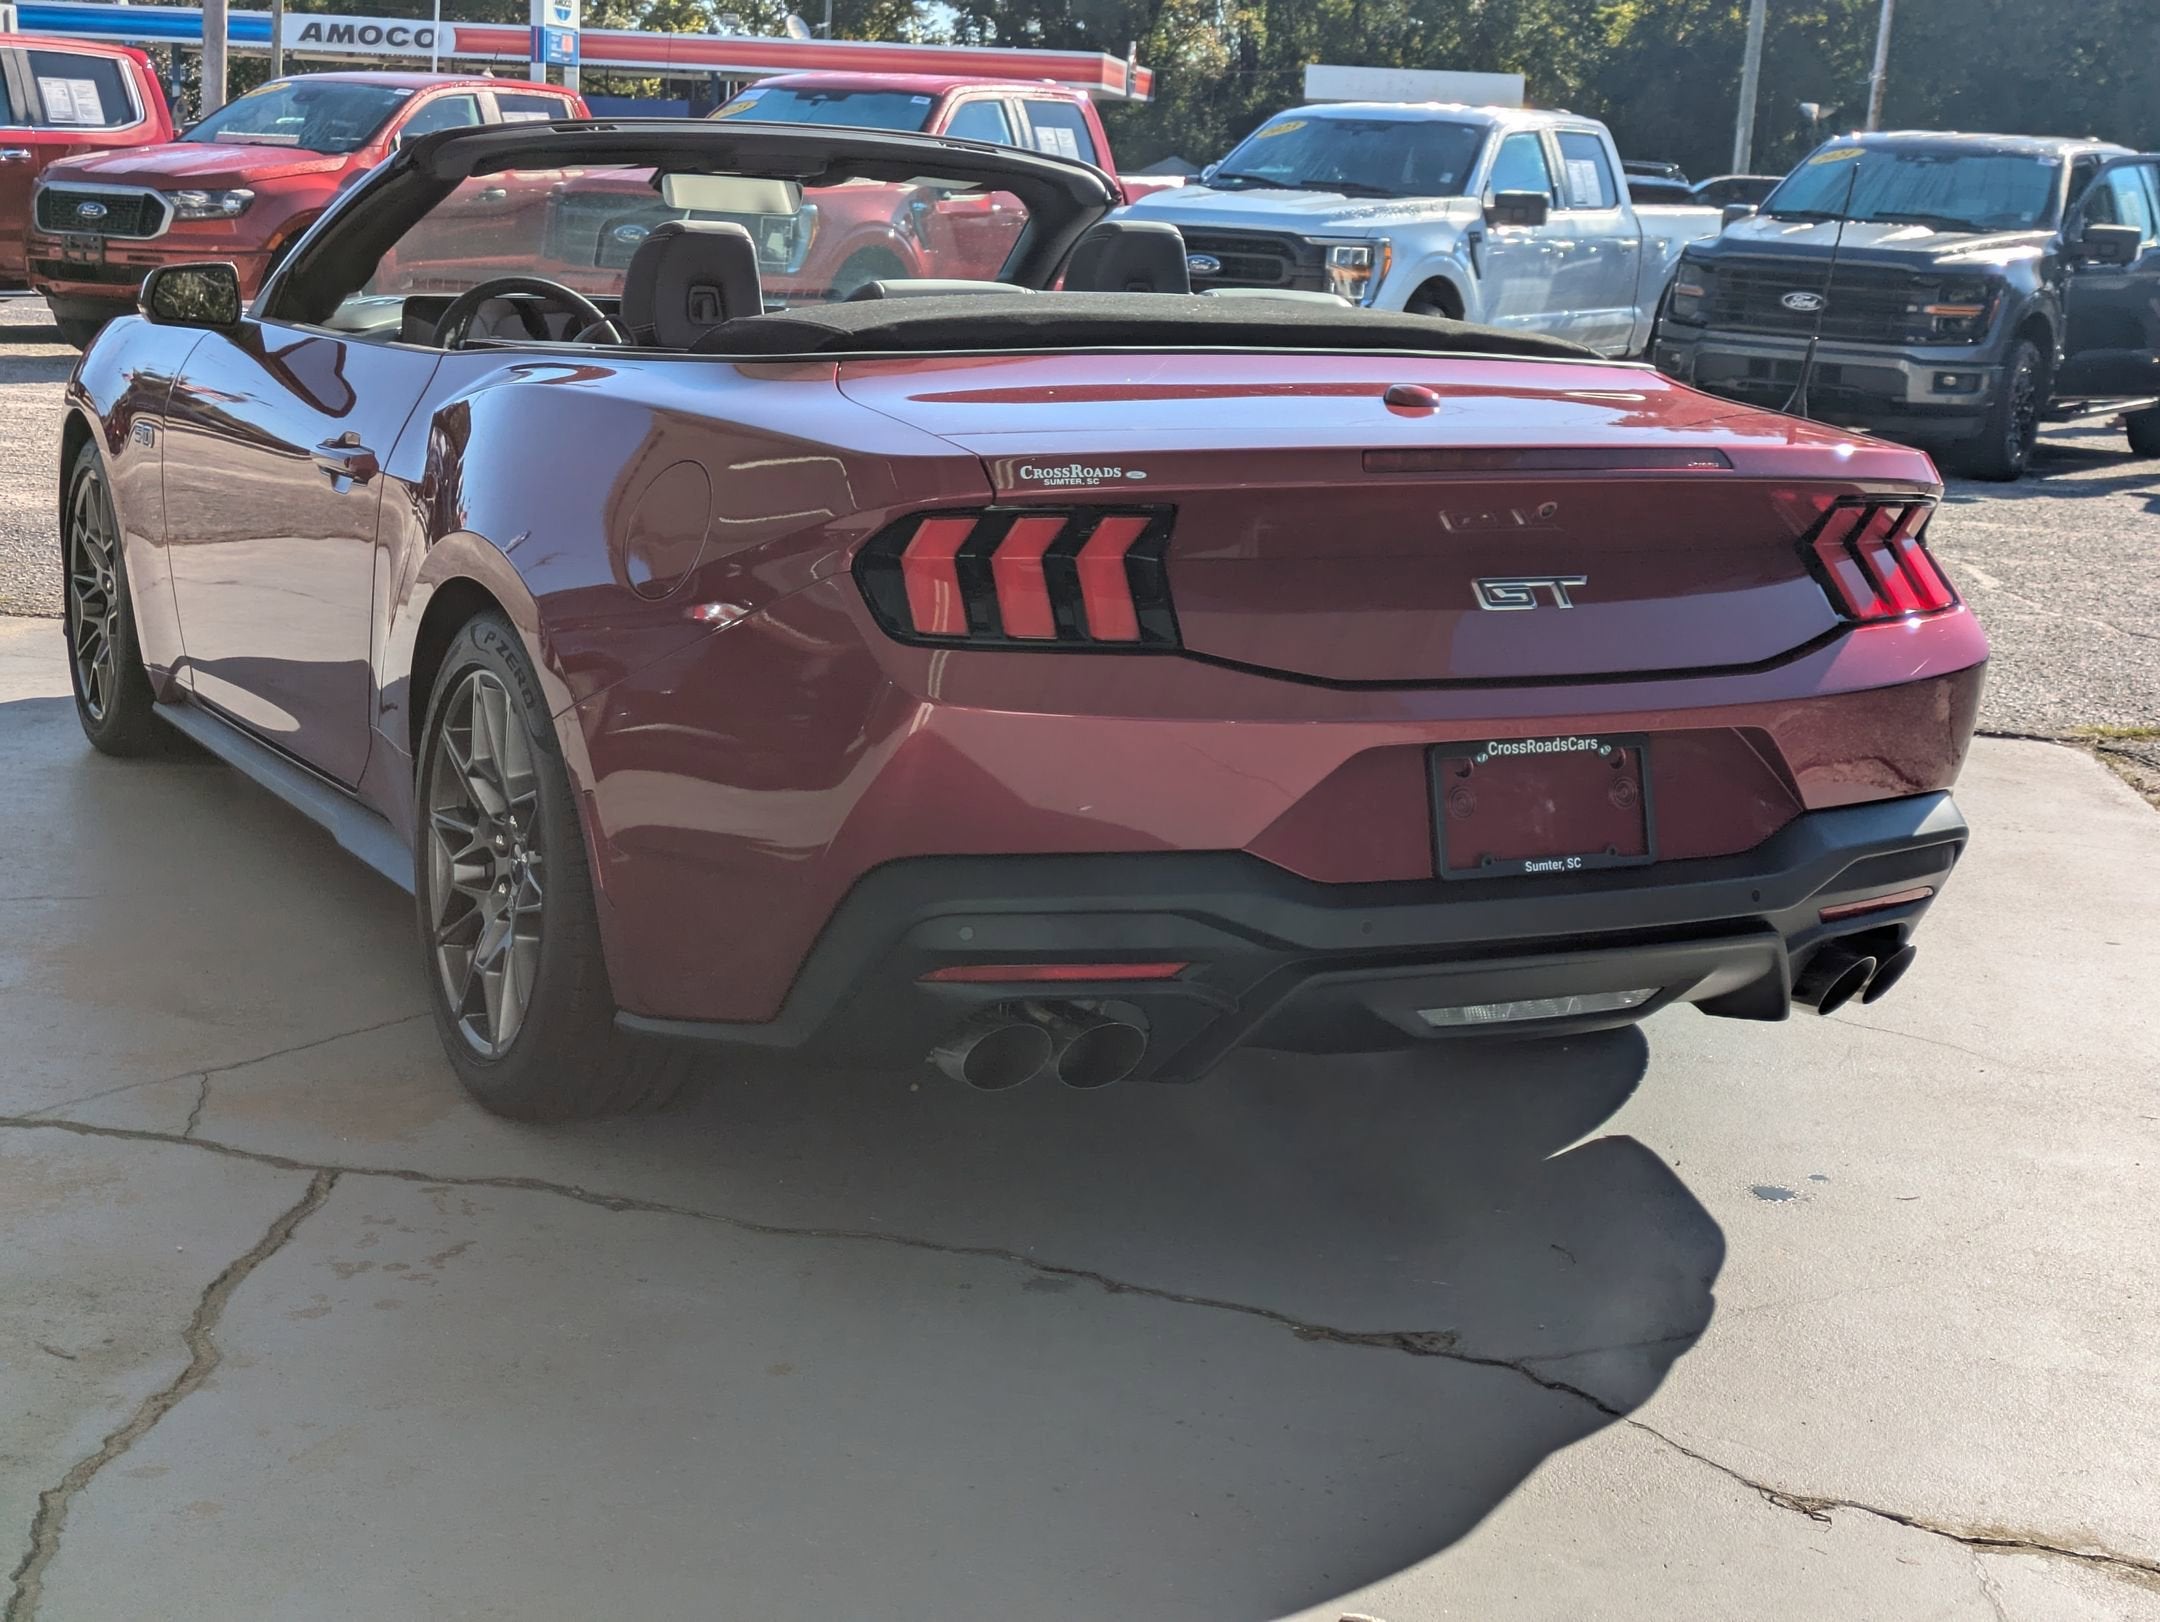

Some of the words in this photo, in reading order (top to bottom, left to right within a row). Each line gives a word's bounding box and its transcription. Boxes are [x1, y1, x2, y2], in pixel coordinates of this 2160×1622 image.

[298, 22, 440, 48] AMOCO
[1787, 294, 1819, 308] Ford
[1471, 575, 1588, 610] GT
[496, 640, 536, 709] ZERO
[1488, 737, 1598, 756] CrossRoadsCars
[1525, 860, 1565, 872] Sumter,
[1566, 857, 1582, 868] SC
